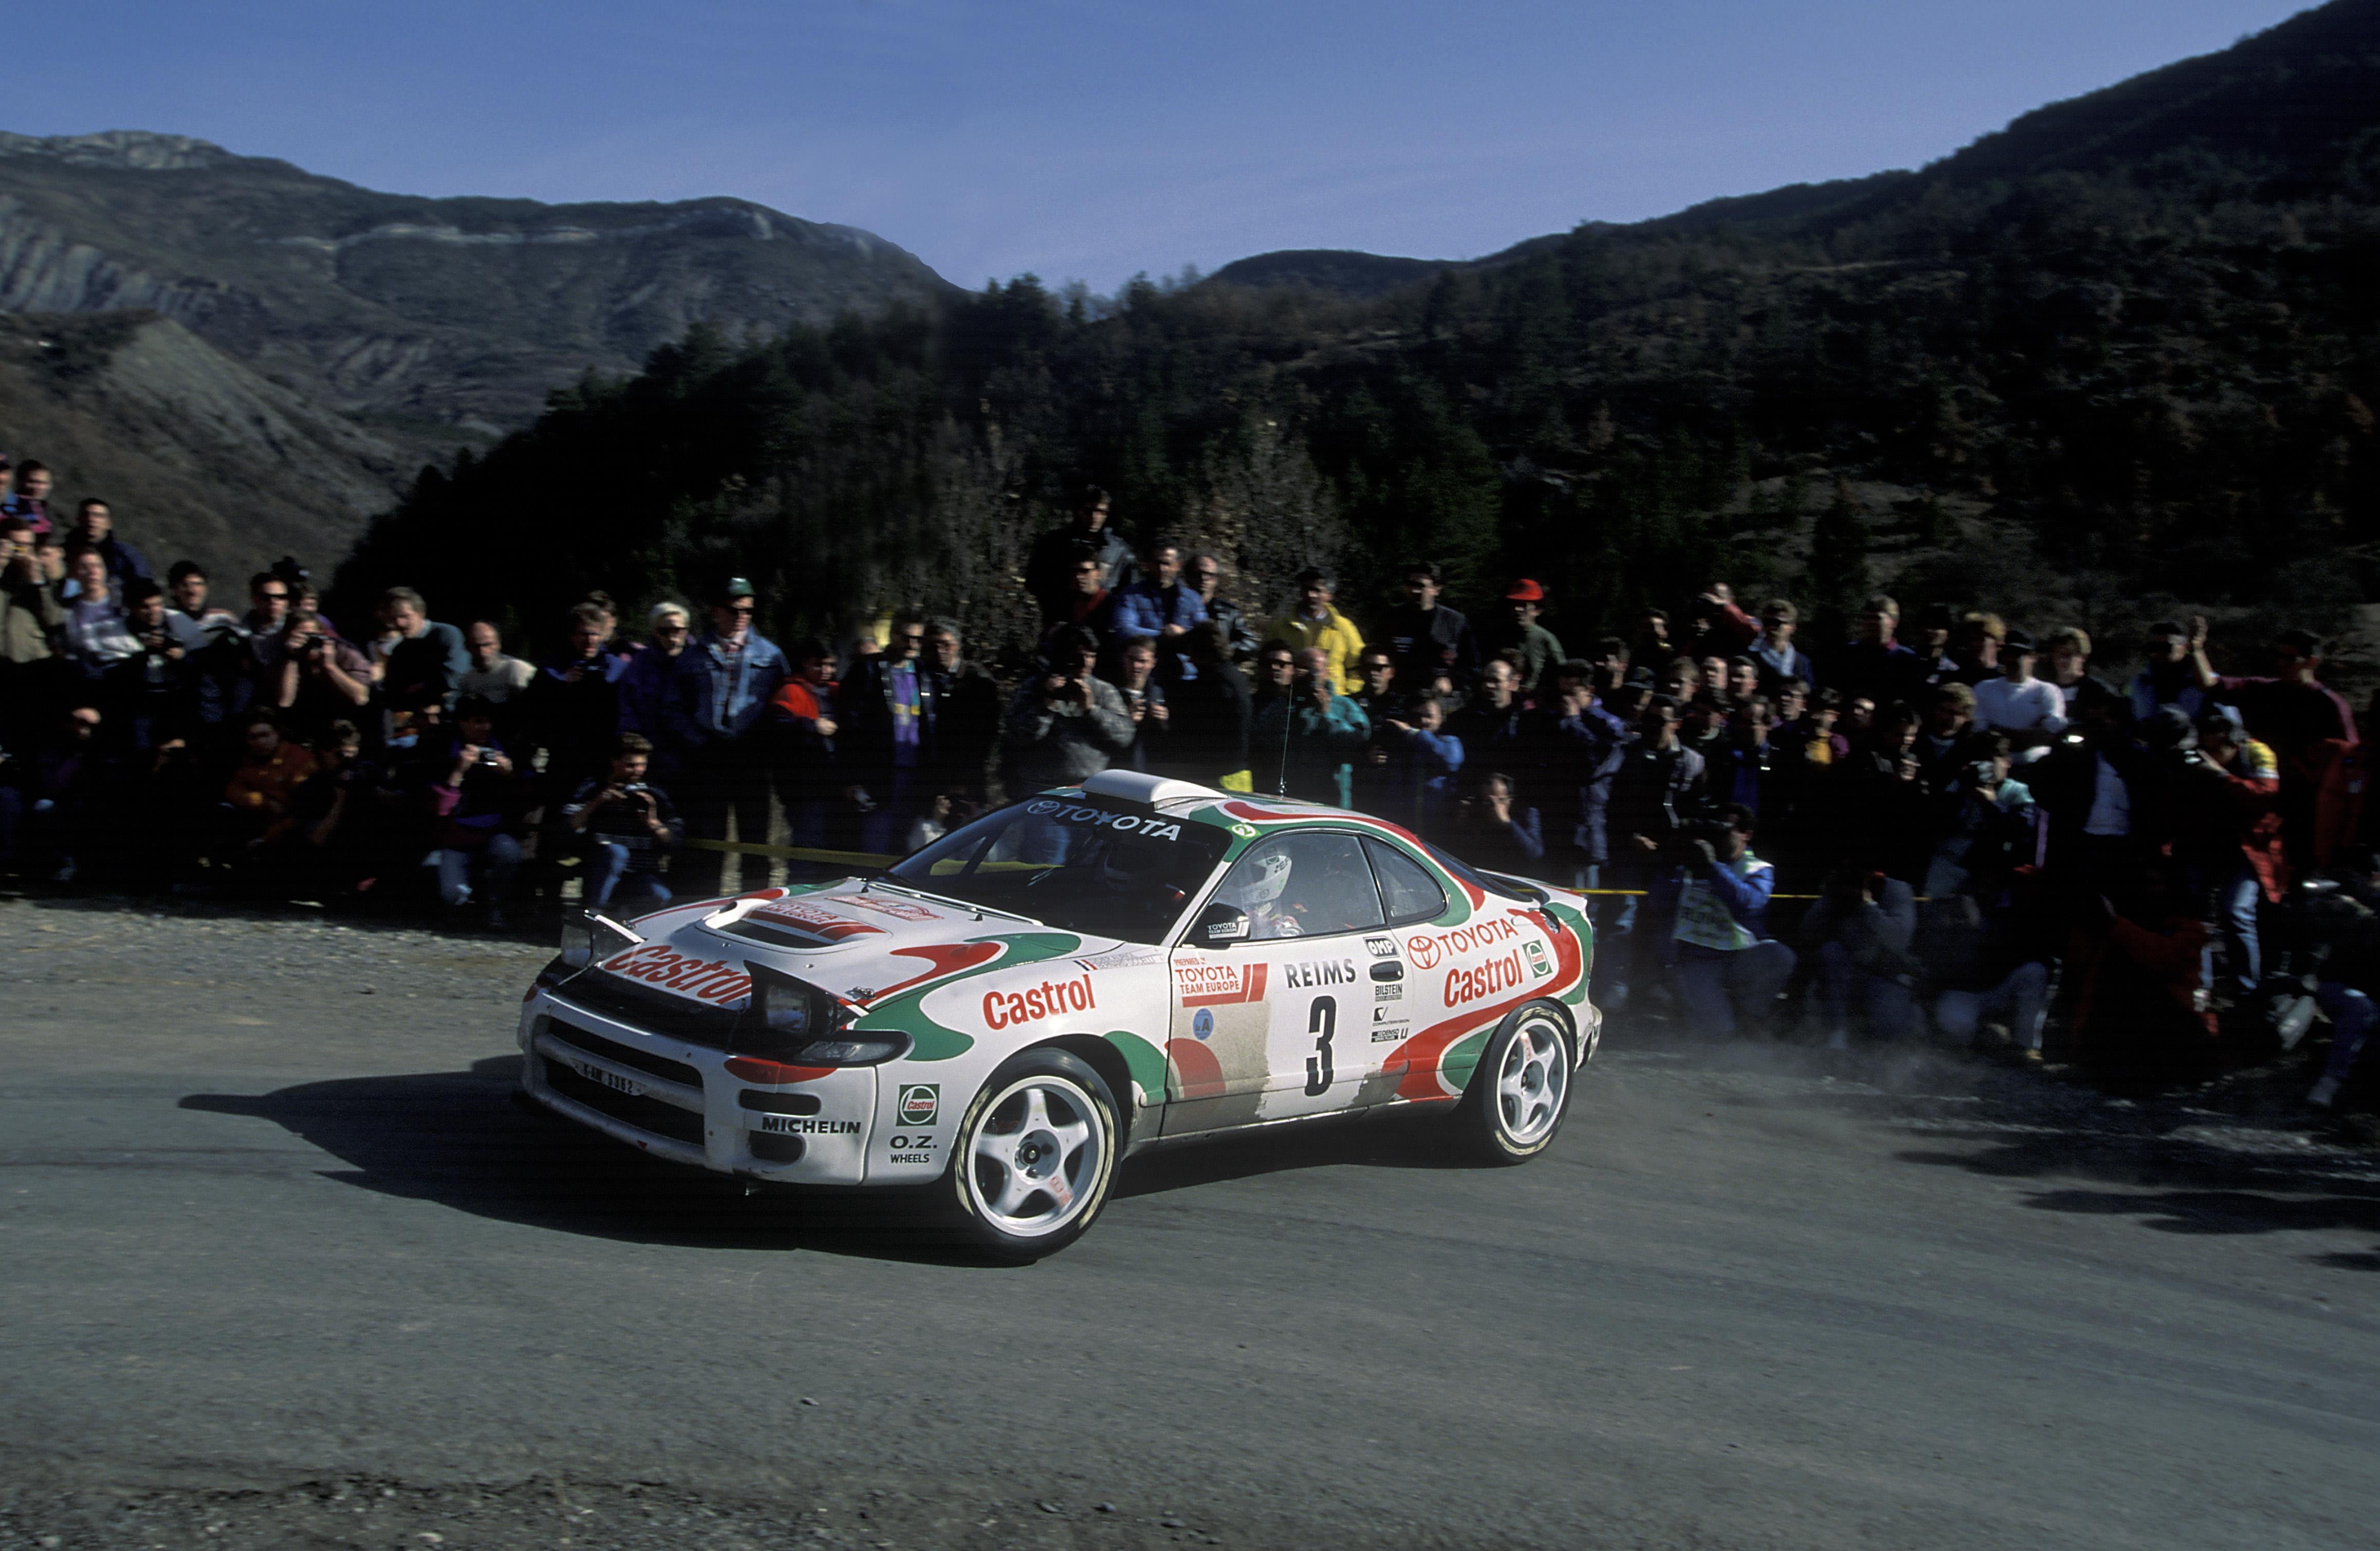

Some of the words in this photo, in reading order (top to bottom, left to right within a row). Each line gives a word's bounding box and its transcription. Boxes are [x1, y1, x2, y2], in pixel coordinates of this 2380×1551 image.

[1055, 805, 1181, 841] TOYOTA
[1439, 918, 1518, 956] TOYOTA
[1368, 940, 1394, 954] OMP
[604, 946, 752, 1004] Castrol
[1175, 966, 1237, 983] TOYOTA
[1284, 958, 1356, 988] REIMS
[1444, 949, 1523, 1008] Castrol
[1180, 983, 1204, 994] TEAM
[1205, 981, 1239, 992] EUROPE
[1375, 984, 1402, 995] BILSTEIN
[983, 974, 1096, 1030] Castrol
[1305, 995, 1337, 1097] 3
[907, 1101, 935, 1110] Castrol
[762, 1117, 861, 1134] MICHELIN
[890, 1135, 938, 1149] O.Z.
[890, 1154, 929, 1164] WHEELS
